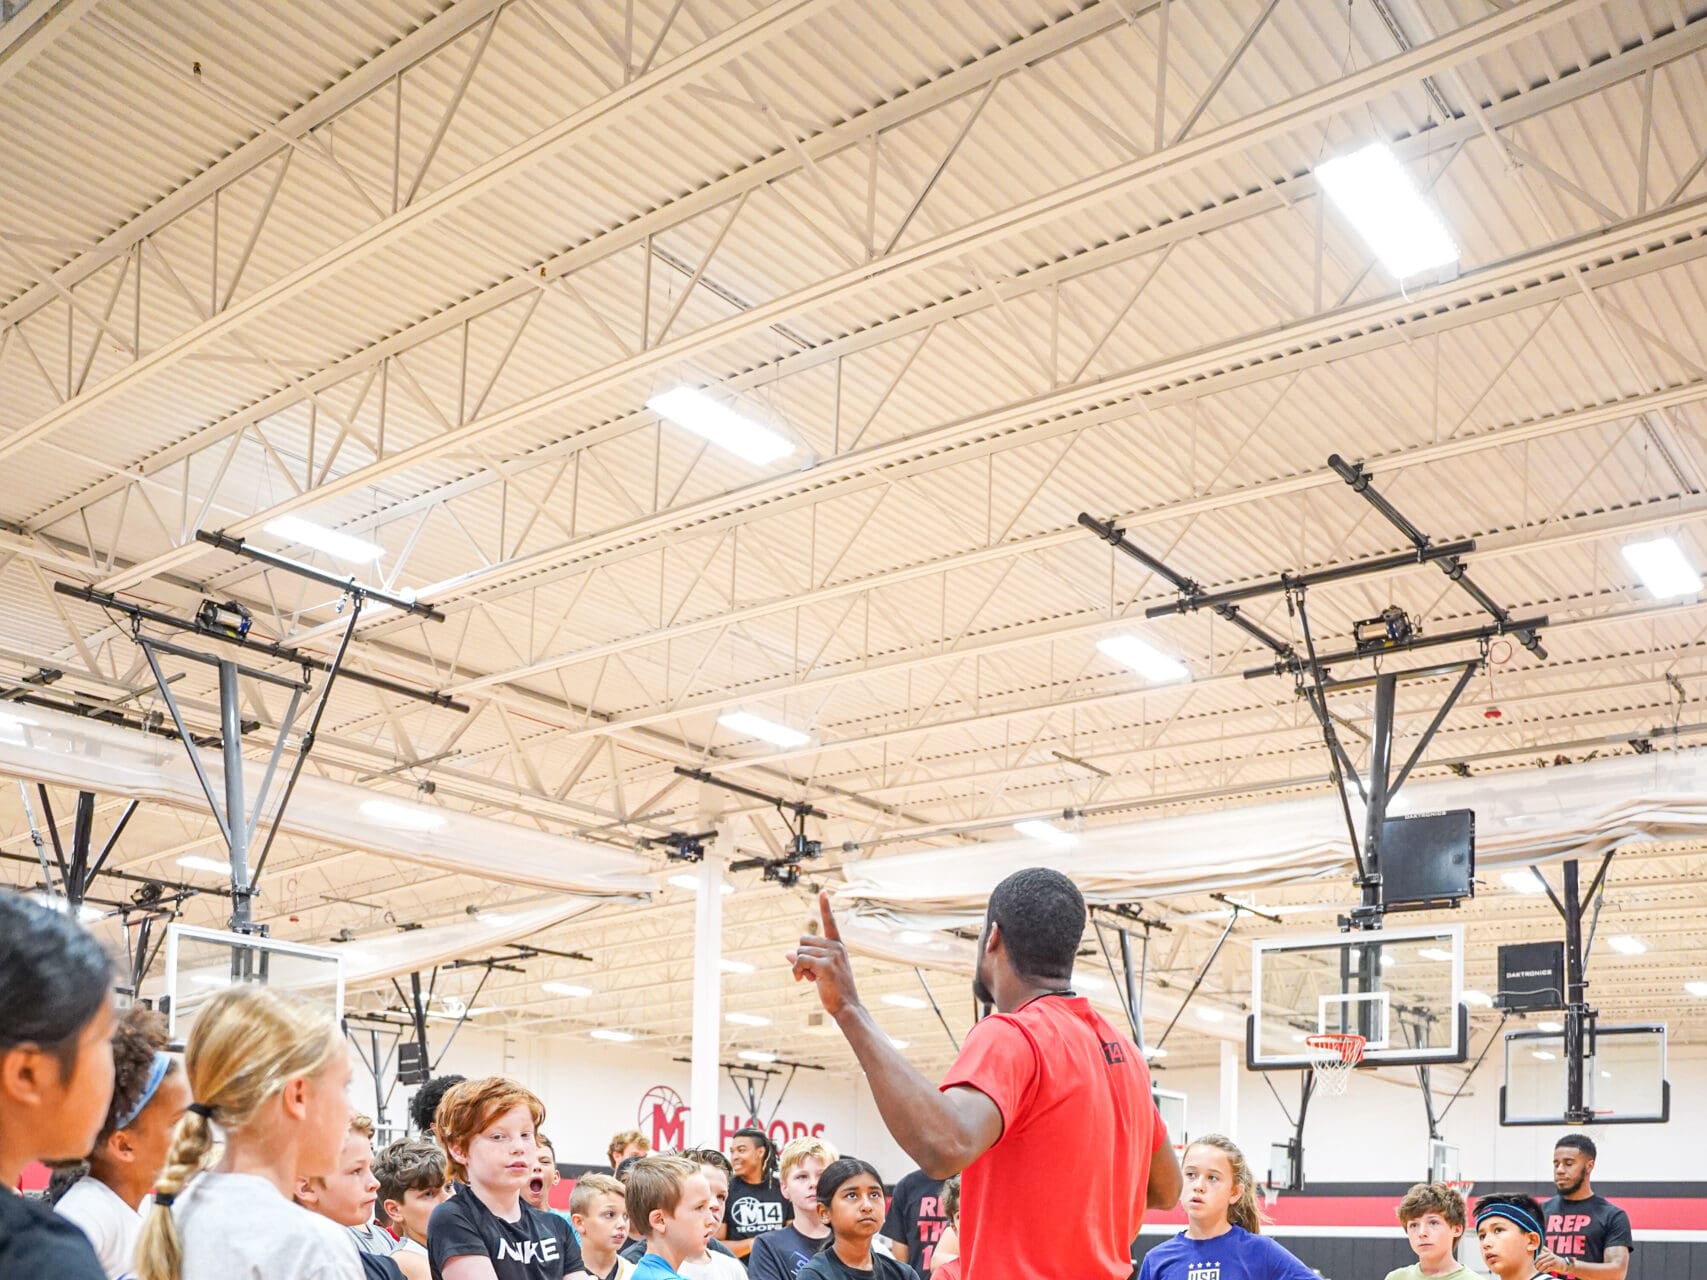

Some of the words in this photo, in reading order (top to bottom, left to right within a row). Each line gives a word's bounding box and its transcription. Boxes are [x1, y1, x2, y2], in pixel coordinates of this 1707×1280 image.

[1506, 969, 1553, 979] DAKTRONICS
[1546, 1214, 1591, 1233] REP
[497, 1237, 560, 1265] NIKE
[1545, 1235, 1586, 1255] THE
